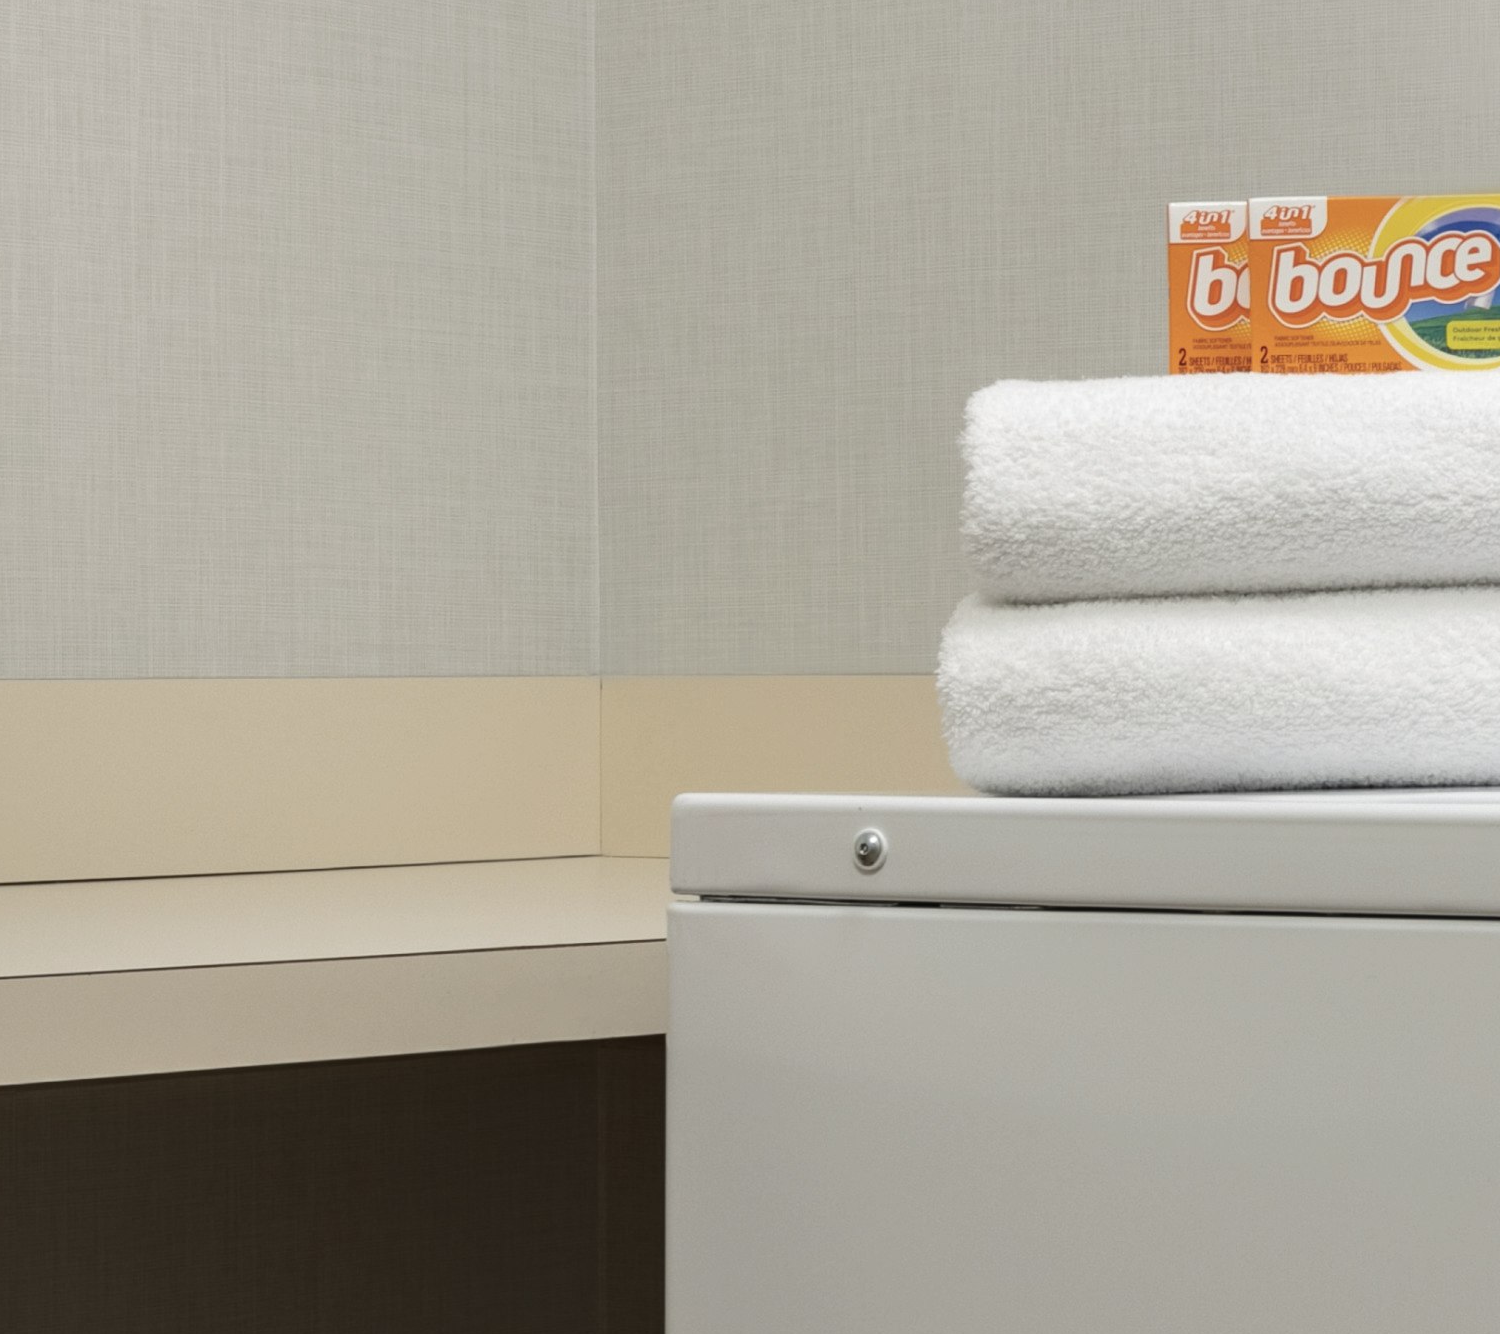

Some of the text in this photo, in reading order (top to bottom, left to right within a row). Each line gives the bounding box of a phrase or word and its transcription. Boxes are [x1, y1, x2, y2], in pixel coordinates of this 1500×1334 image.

[1193, 254, 1250, 316] b
[1275, 237, 1492, 314] bounce
[1179, 348, 1187, 366] 2
[1260, 346, 1268, 364] 2
